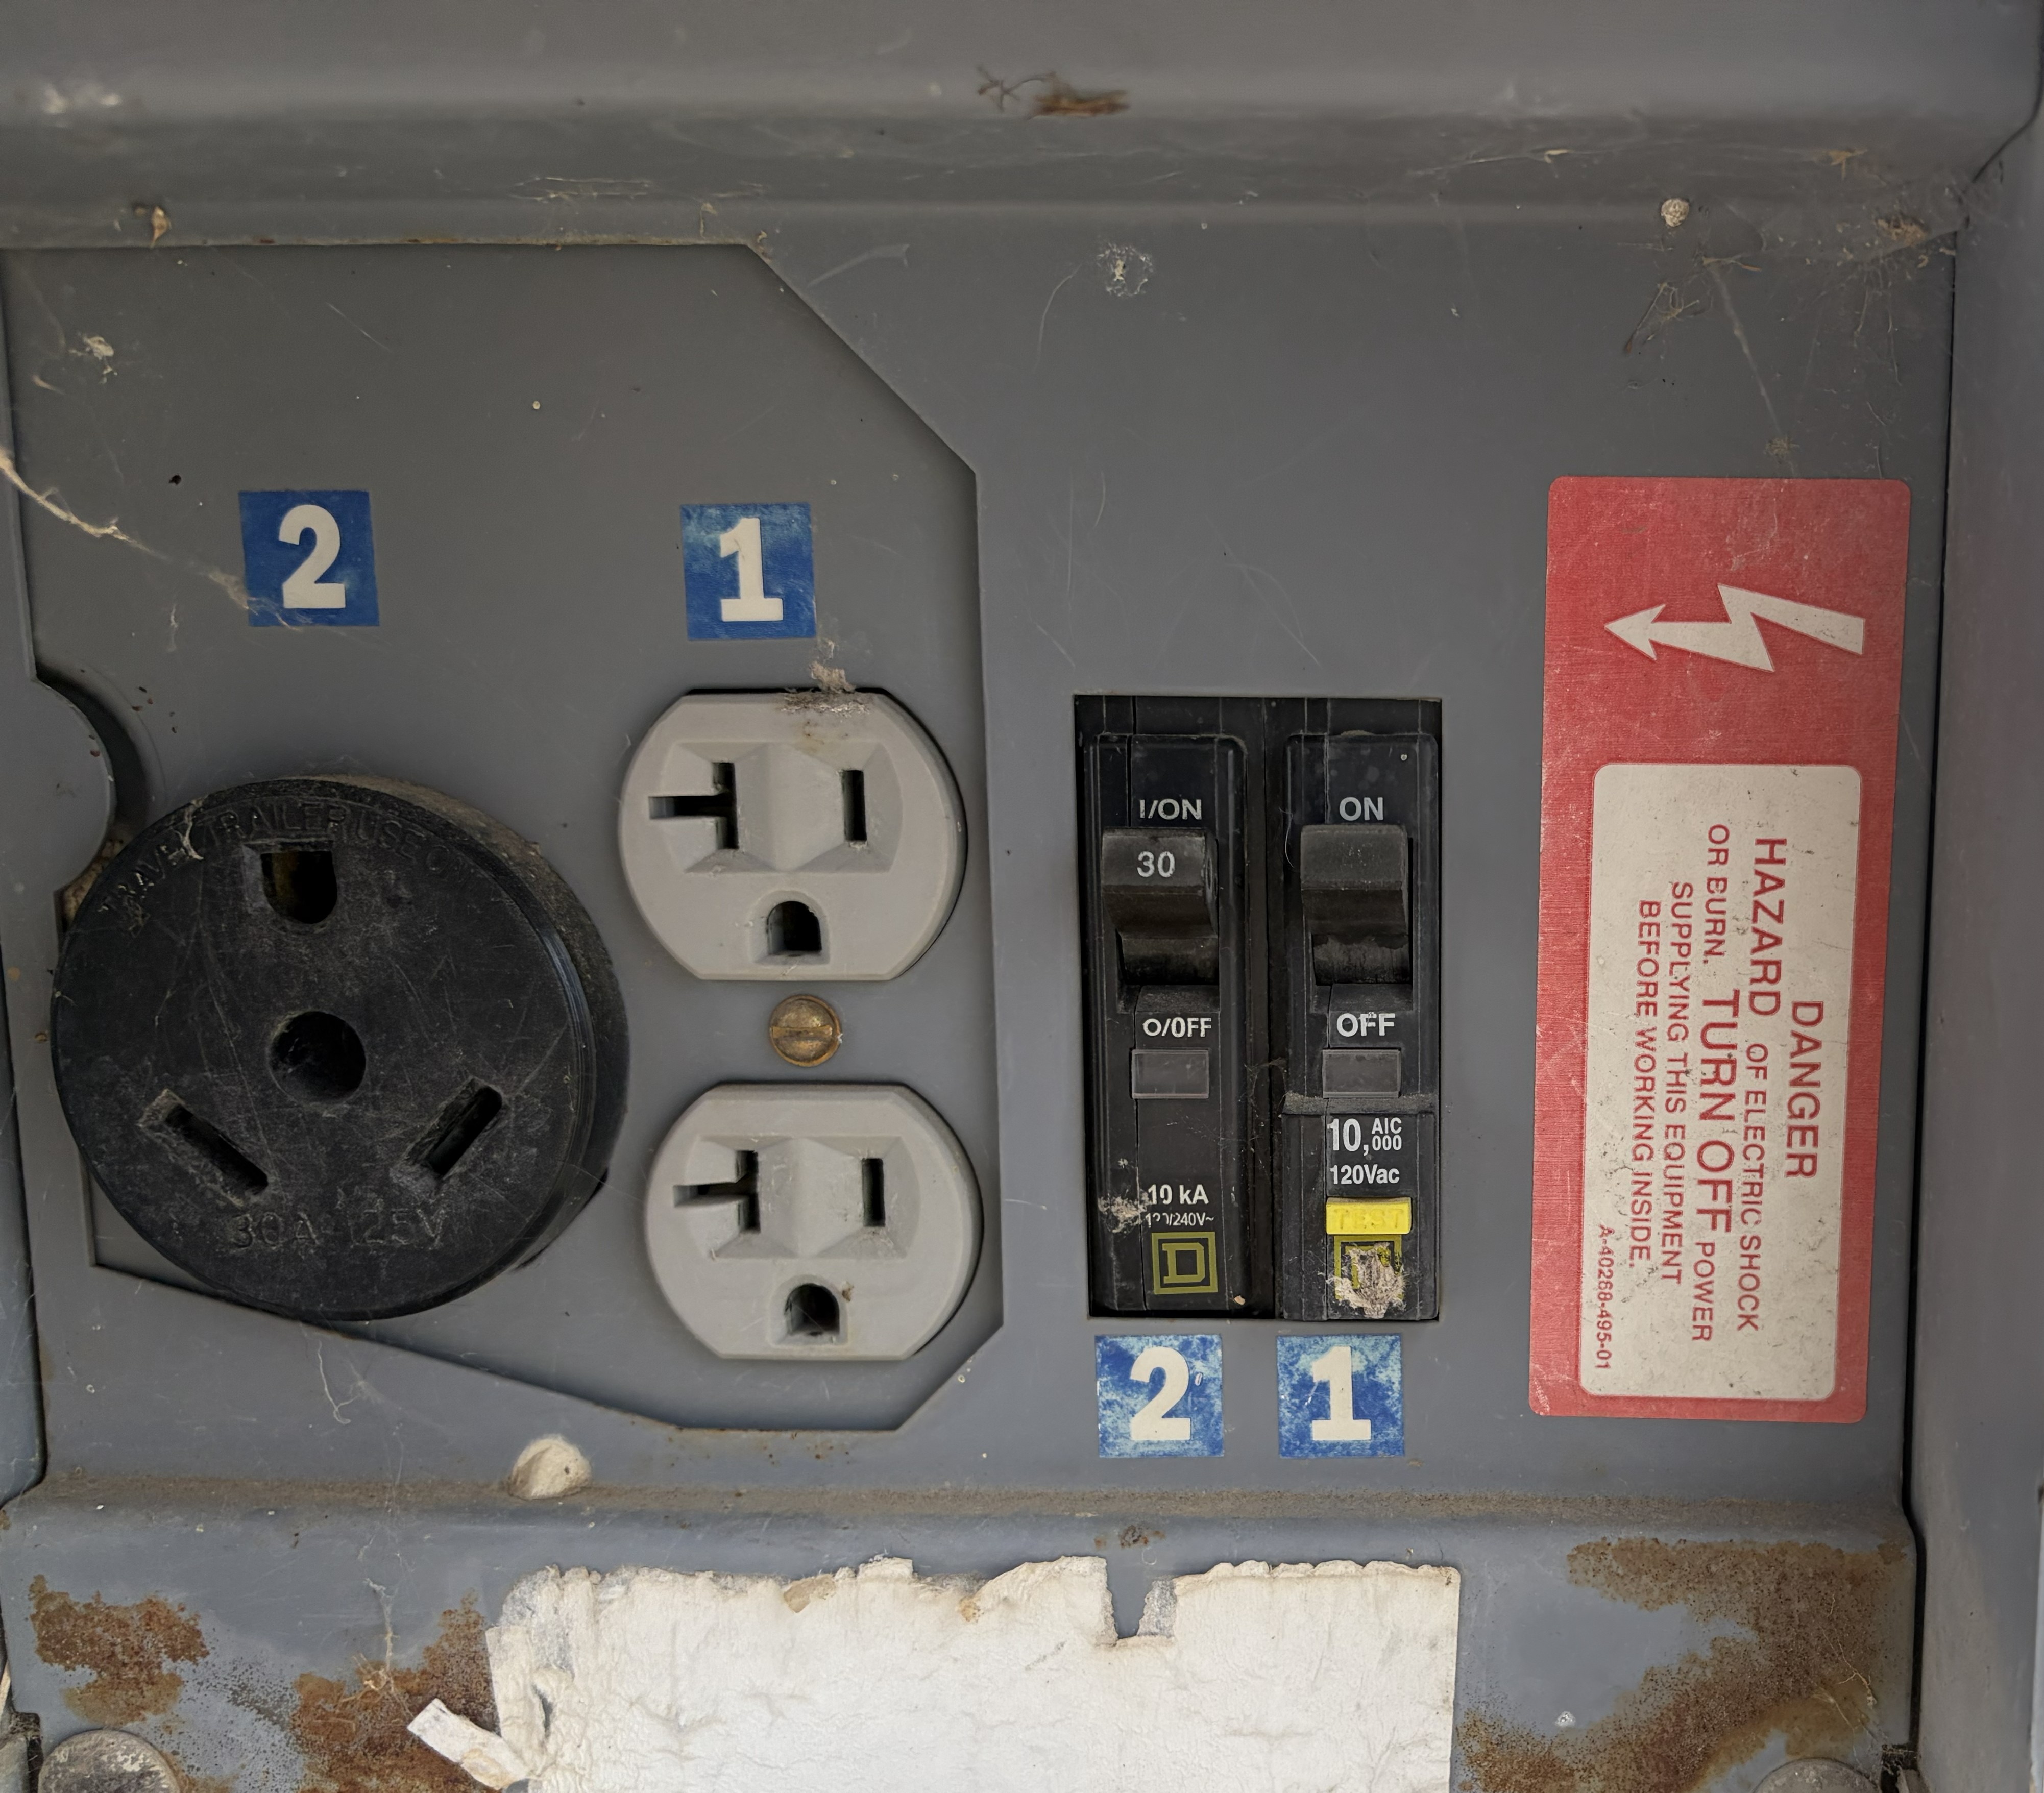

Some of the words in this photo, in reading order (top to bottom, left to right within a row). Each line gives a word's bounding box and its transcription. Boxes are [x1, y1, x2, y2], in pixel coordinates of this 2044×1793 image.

[279, 504, 345, 608] 2
[719, 518, 784, 622] 1
[1139, 798, 1202, 820] I/ON
[1339, 797, 1383, 821] ON
[1707, 824, 1730, 866] OR
[1137, 851, 1175, 877] 30
[1636, 900, 1662, 1017] BEFORE
[1667, 881, 1694, 1042] SUPPLYING
[1702, 877, 1728, 964] BURN.
[1748, 838, 1787, 1017] HAZARD
[1336, 1011, 1396, 1037] OFF
[1699, 989, 1740, 1121] TURN
[1746, 1043, 1769, 1080] OF
[1371, 1117, 1402, 1134] AIC
[1632, 1026, 1657, 1162] WORKING
[1664, 1052, 1688, 1114] THIS
[1784, 1001, 1824, 1177] DANGER
[1148, 1184, 1173, 1205] 10
[1179, 1184, 1209, 1205] kA
[1329, 1164, 1400, 1185] 120Vac
[1661, 1123, 1686, 1285] EQUIPMENT
[1696, 1139, 1735, 1233] OFF
[1740, 1090, 1767, 1225] ELECTRIC
[1333, 1207, 1405, 1231] TEST
[1628, 1171, 1653, 1268] INSIDE.
[1692, 1241, 1715, 1342] POWER
[1737, 1234, 1762, 1331] SHOCK
[1130, 1346, 1191, 1440] 2
[1312, 1346, 1371, 1441] 1
